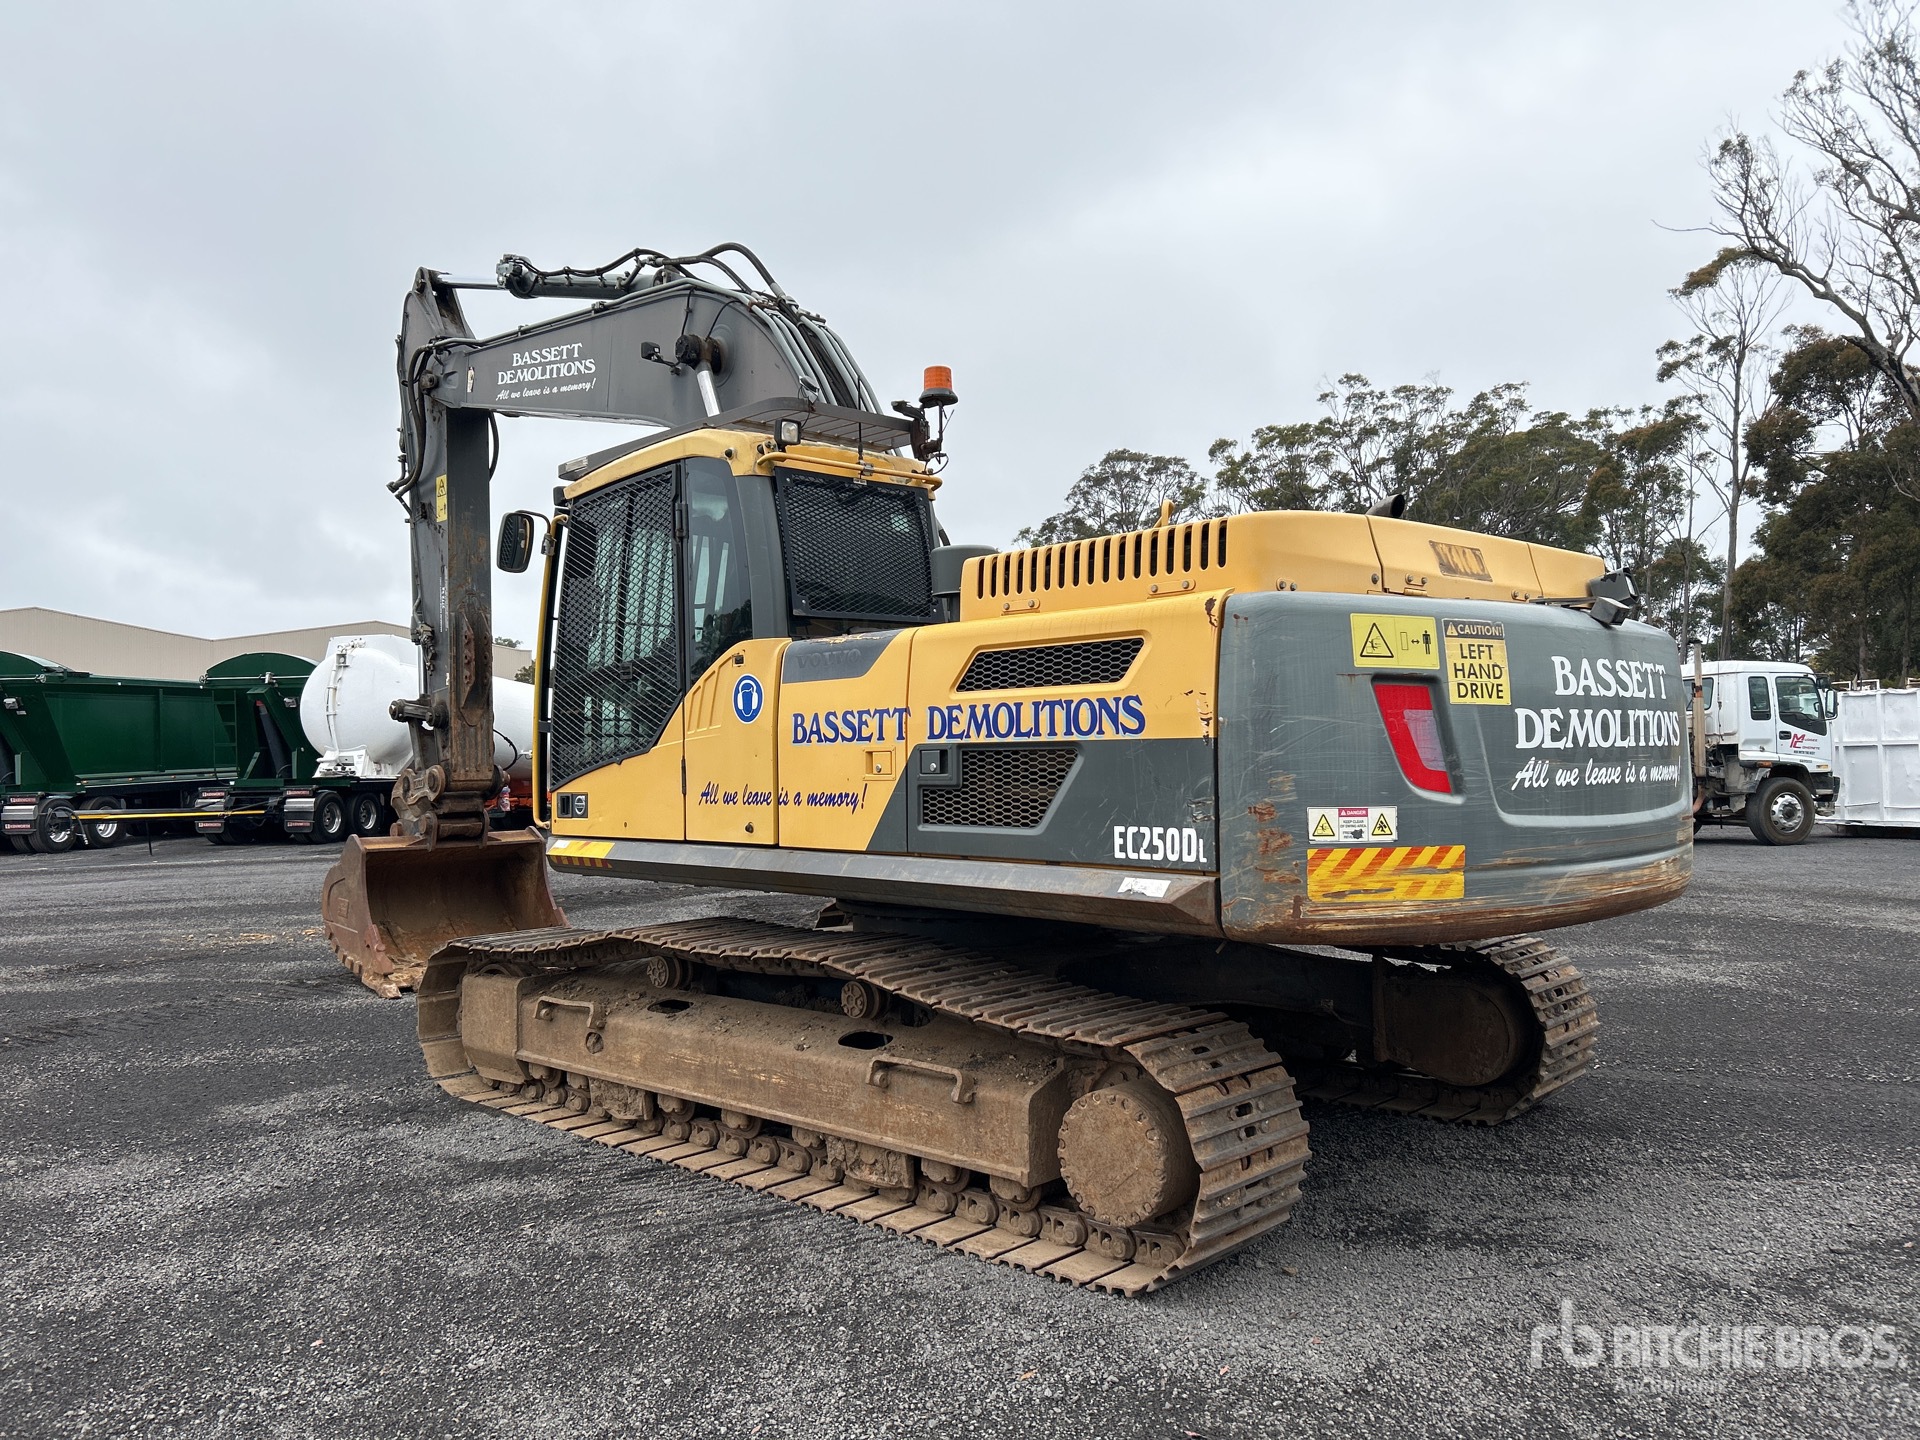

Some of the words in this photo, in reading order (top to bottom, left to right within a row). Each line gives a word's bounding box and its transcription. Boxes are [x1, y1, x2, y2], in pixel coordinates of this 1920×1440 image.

[512, 342, 583, 367] BASSETT
[497, 358, 596, 385] DEMOLITIONS
[495, 389, 510, 401] All
[510, 391, 521, 399] we
[522, 387, 541, 398] leave
[542, 386, 550, 395] is
[560, 377, 597, 393] memory!
[1457, 624, 1503, 637] CAUTION!
[795, 648, 862, 669] VOLVO
[1459, 643, 1494, 660] LEFT
[1453, 662, 1503, 680] HAND
[1551, 655, 1667, 700] BASSETT
[1456, 682, 1504, 699] DRIVE
[792, 705, 912, 745] BASSETT
[926, 694, 1147, 742] DEMOLITIONS
[1514, 707, 1681, 750] DEMOLITIONS
[1511, 756, 1550, 791] All
[1555, 766, 1580, 791] we
[1585, 758, 1622, 786] leave
[1625, 760, 1637, 783] is
[1639, 767, 1648, 783] a
[1650, 755, 1681, 788] memory!
[698, 781, 720, 806] All
[722, 790, 739, 806] we
[742, 783, 773, 806] leave
[778, 787, 790, 807] is
[793, 791, 803, 807] a
[806, 783, 868, 815] memory!
